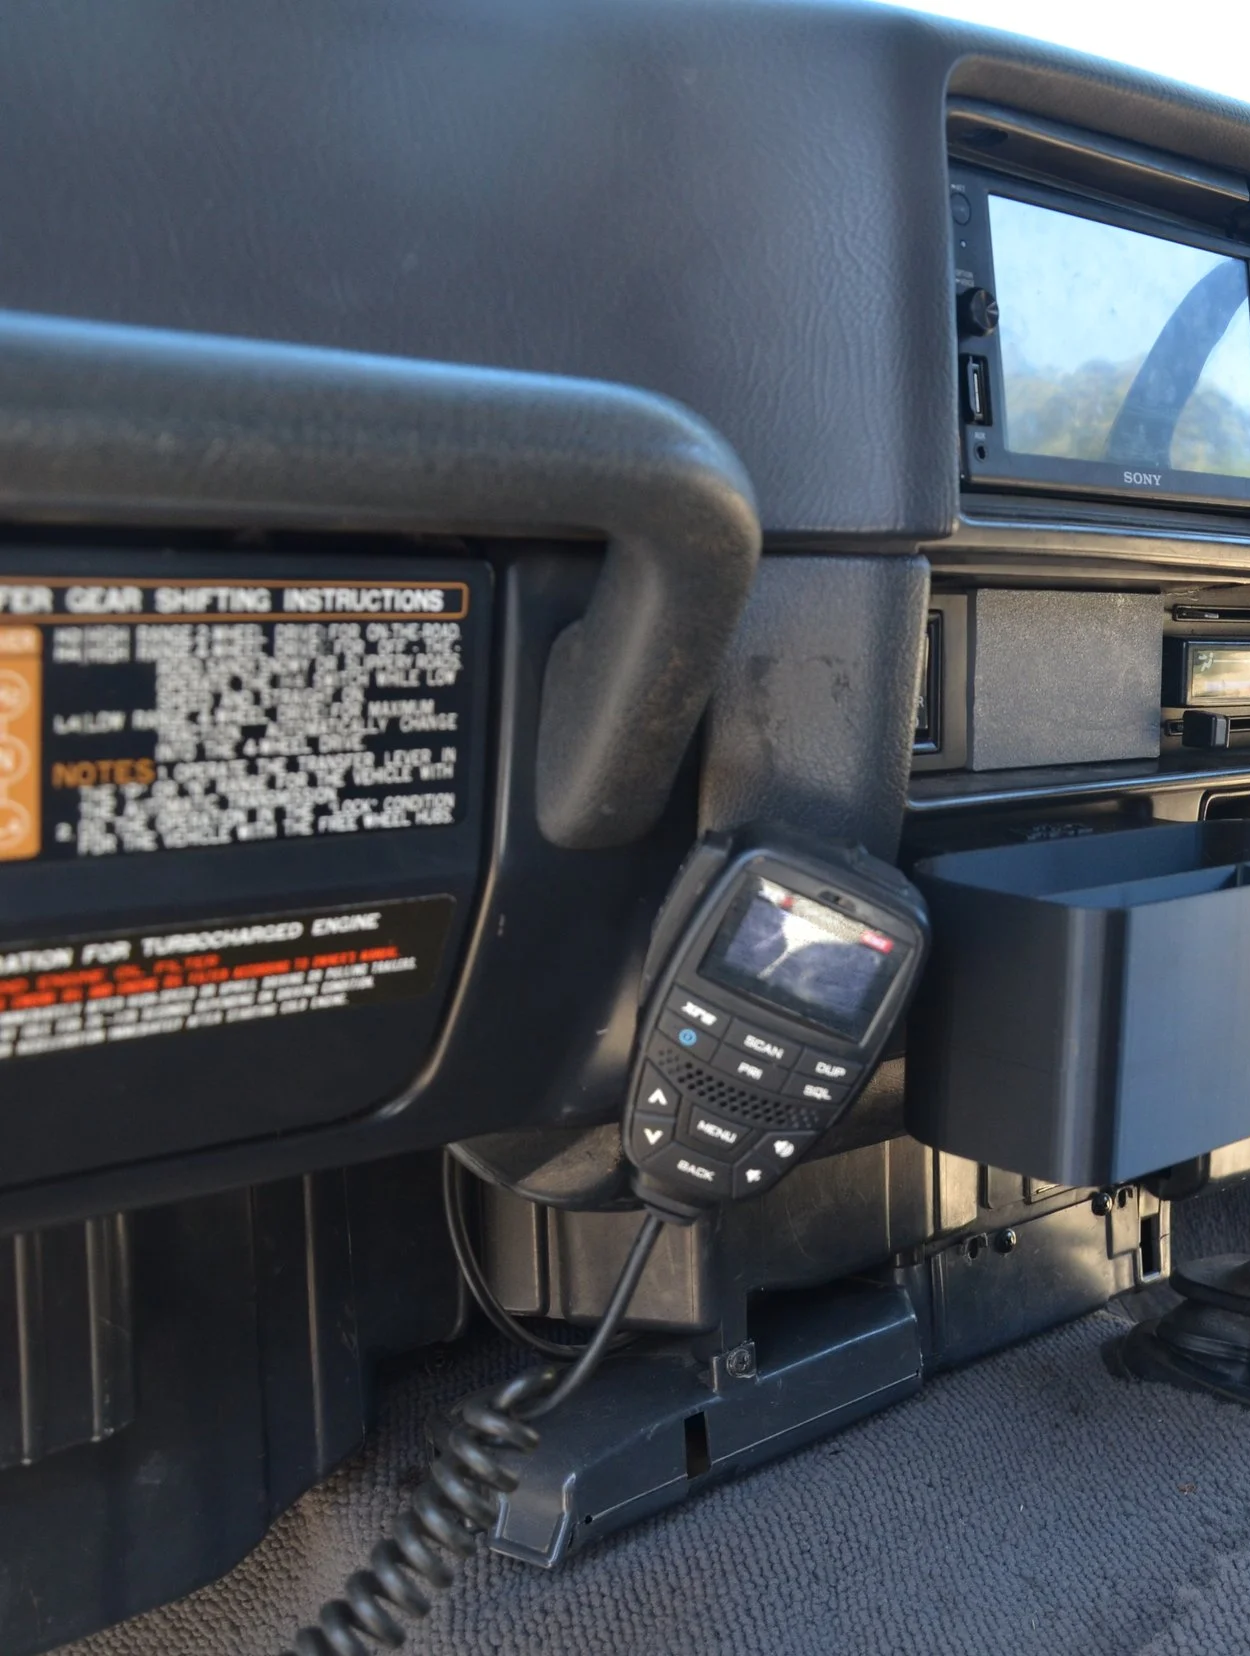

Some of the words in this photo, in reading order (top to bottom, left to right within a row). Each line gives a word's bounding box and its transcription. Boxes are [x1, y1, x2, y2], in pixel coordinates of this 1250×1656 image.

[1123, 471, 1162, 486] SONY
[155, 587, 272, 614] SHIFTING
[283, 588, 444, 612] INSTRUCTIONS
[52, 757, 156, 788] NOTES
[81, 940, 132, 965] FOR
[141, 921, 304, 957] TURBOCHARGED
[311, 912, 382, 936] ENGINE
[743, 1034, 784, 1059] SCAN
[815, 1061, 847, 1078] DUP
[803, 1084, 832, 1101] SQL
[697, 1119, 737, 1144] MENU
[677, 1159, 716, 1182] BACK
